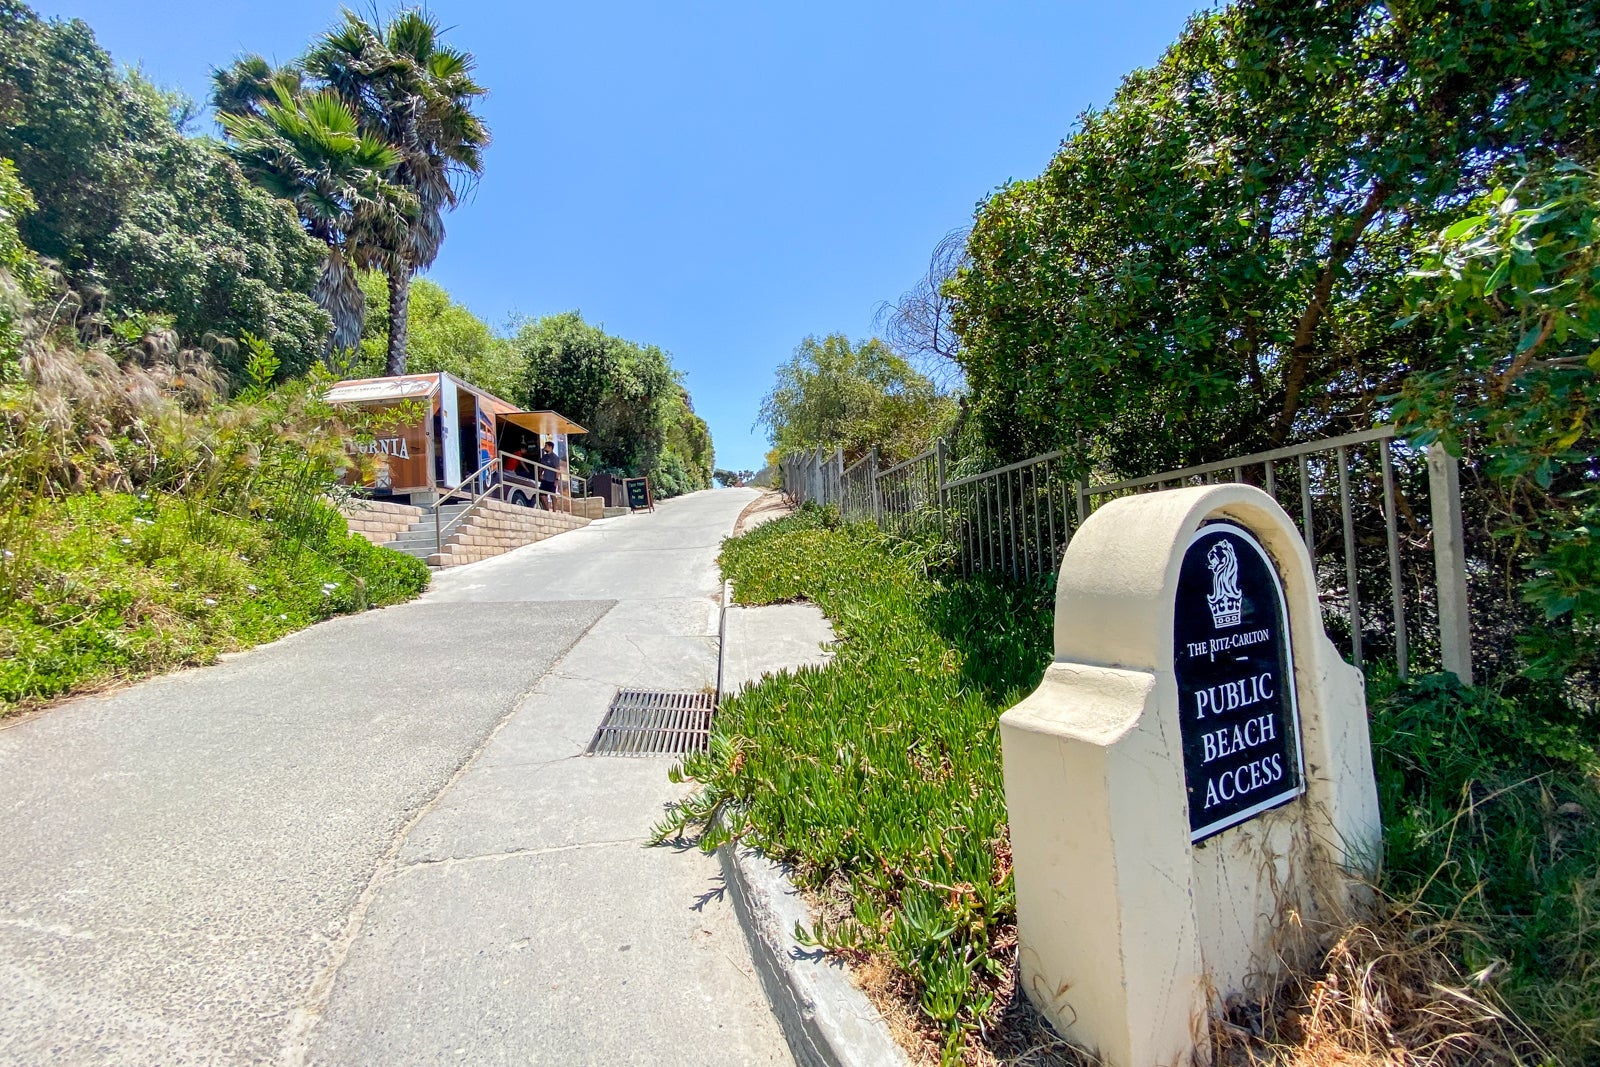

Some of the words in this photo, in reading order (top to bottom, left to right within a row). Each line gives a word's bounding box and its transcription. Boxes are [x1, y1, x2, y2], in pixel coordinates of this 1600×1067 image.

[1187, 641, 1208, 657] THE
[1209, 628, 1270, 653] RITZ-CARLTON
[1194, 672, 1274, 719] PUBLIC
[1201, 713, 1276, 763] BEACH
[1203, 753, 1282, 809] ACCESS
